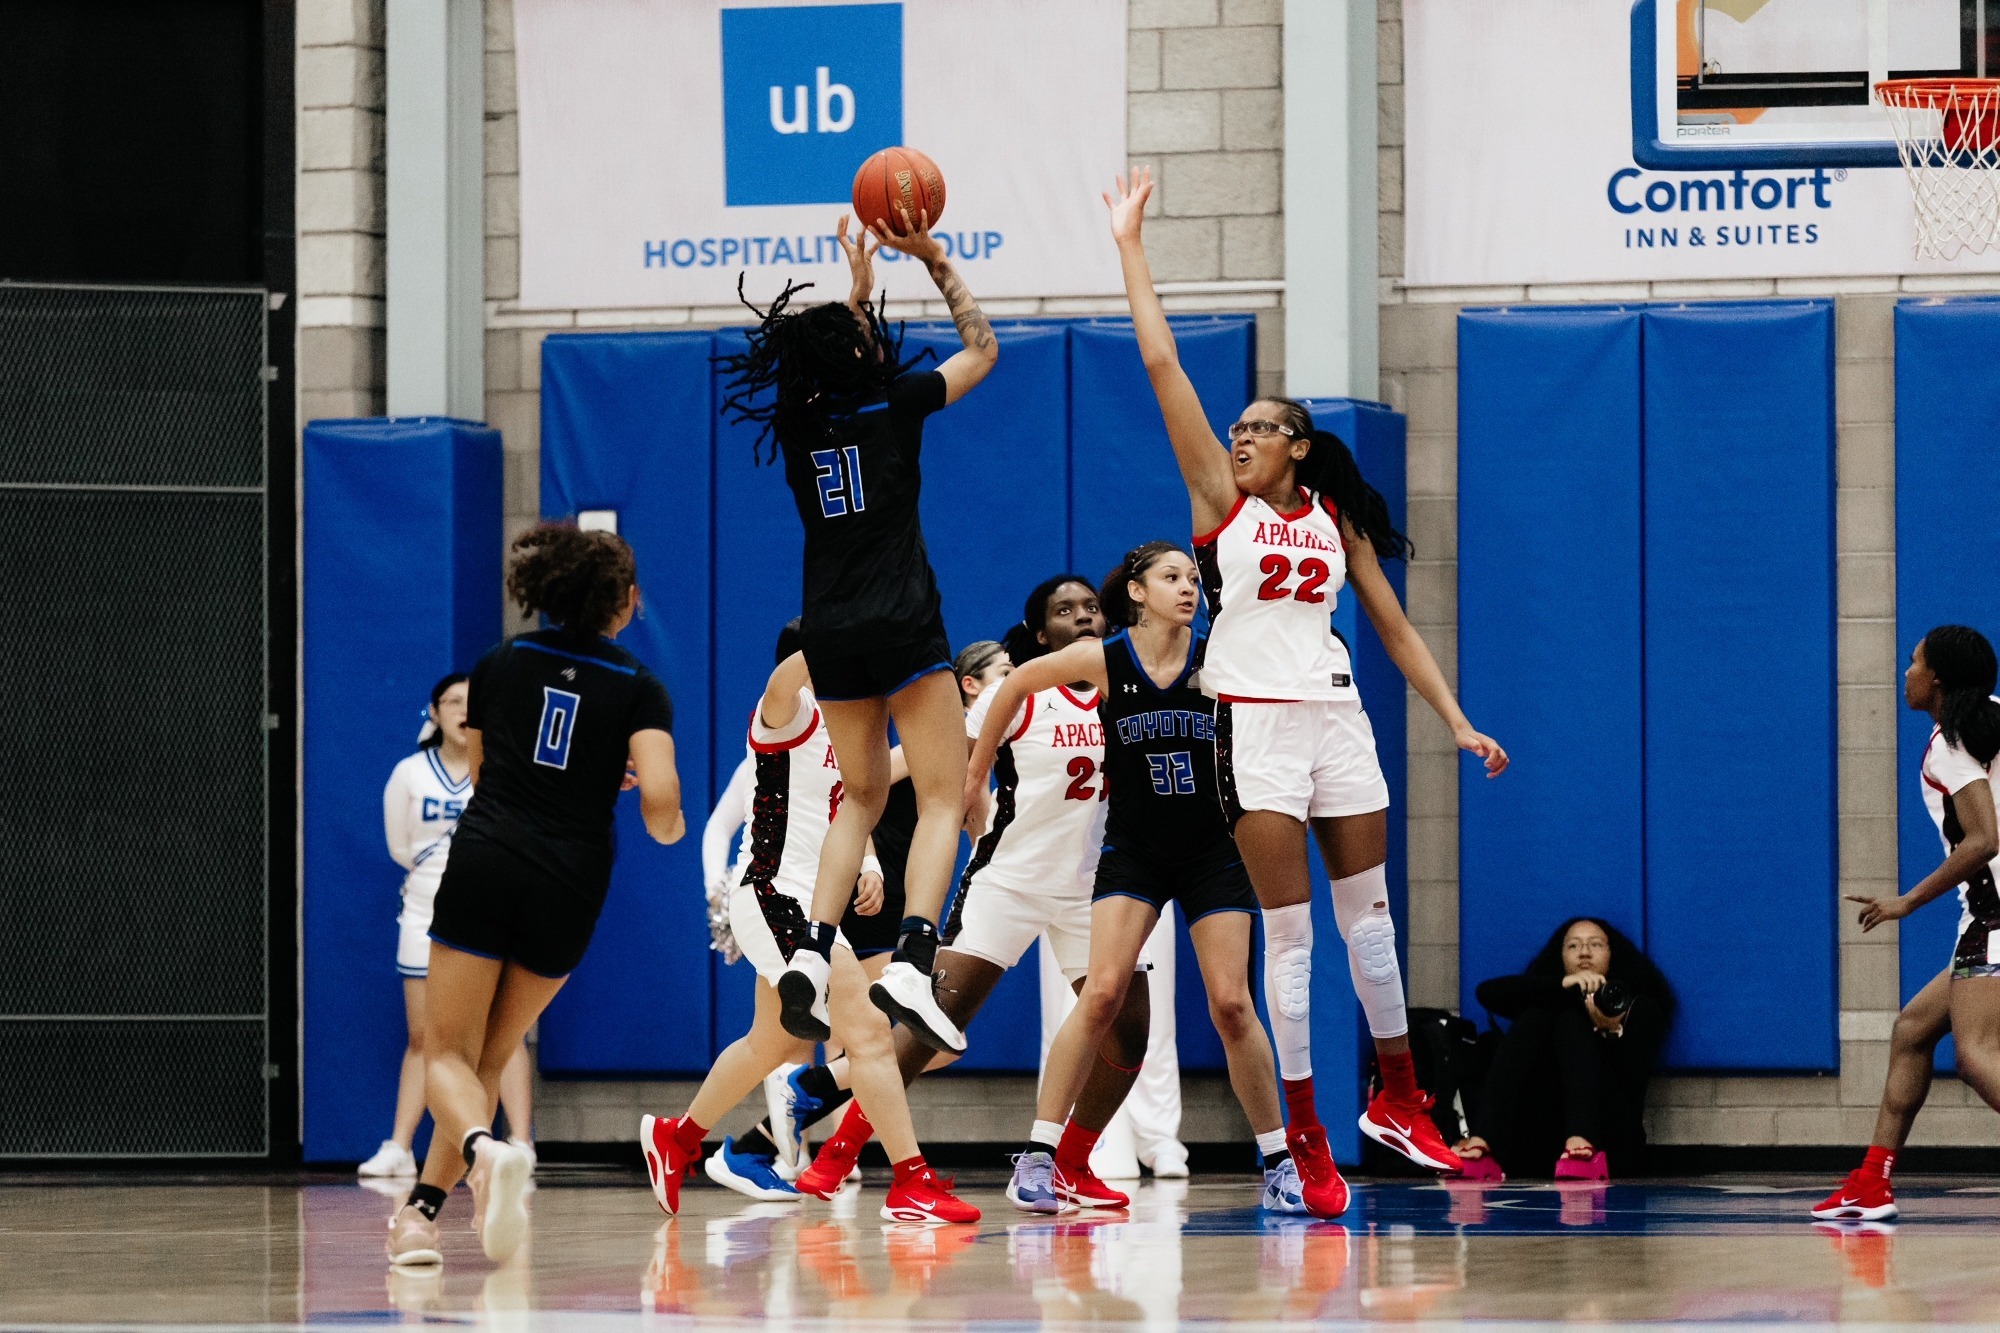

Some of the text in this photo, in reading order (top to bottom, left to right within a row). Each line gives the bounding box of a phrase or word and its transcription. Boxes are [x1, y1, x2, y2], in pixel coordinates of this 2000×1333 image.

[769, 65, 856, 134] ub
[643, 234, 866, 269] HOSPITALIT
[1625, 223, 1819, 248] INN & SUITES
[810, 445, 865, 518] 21
[1257, 553, 1331, 604] 22
[533, 686, 581, 770] 0
[1116, 709, 1216, 745] COYOTES
[1145, 750, 1196, 795] 32
